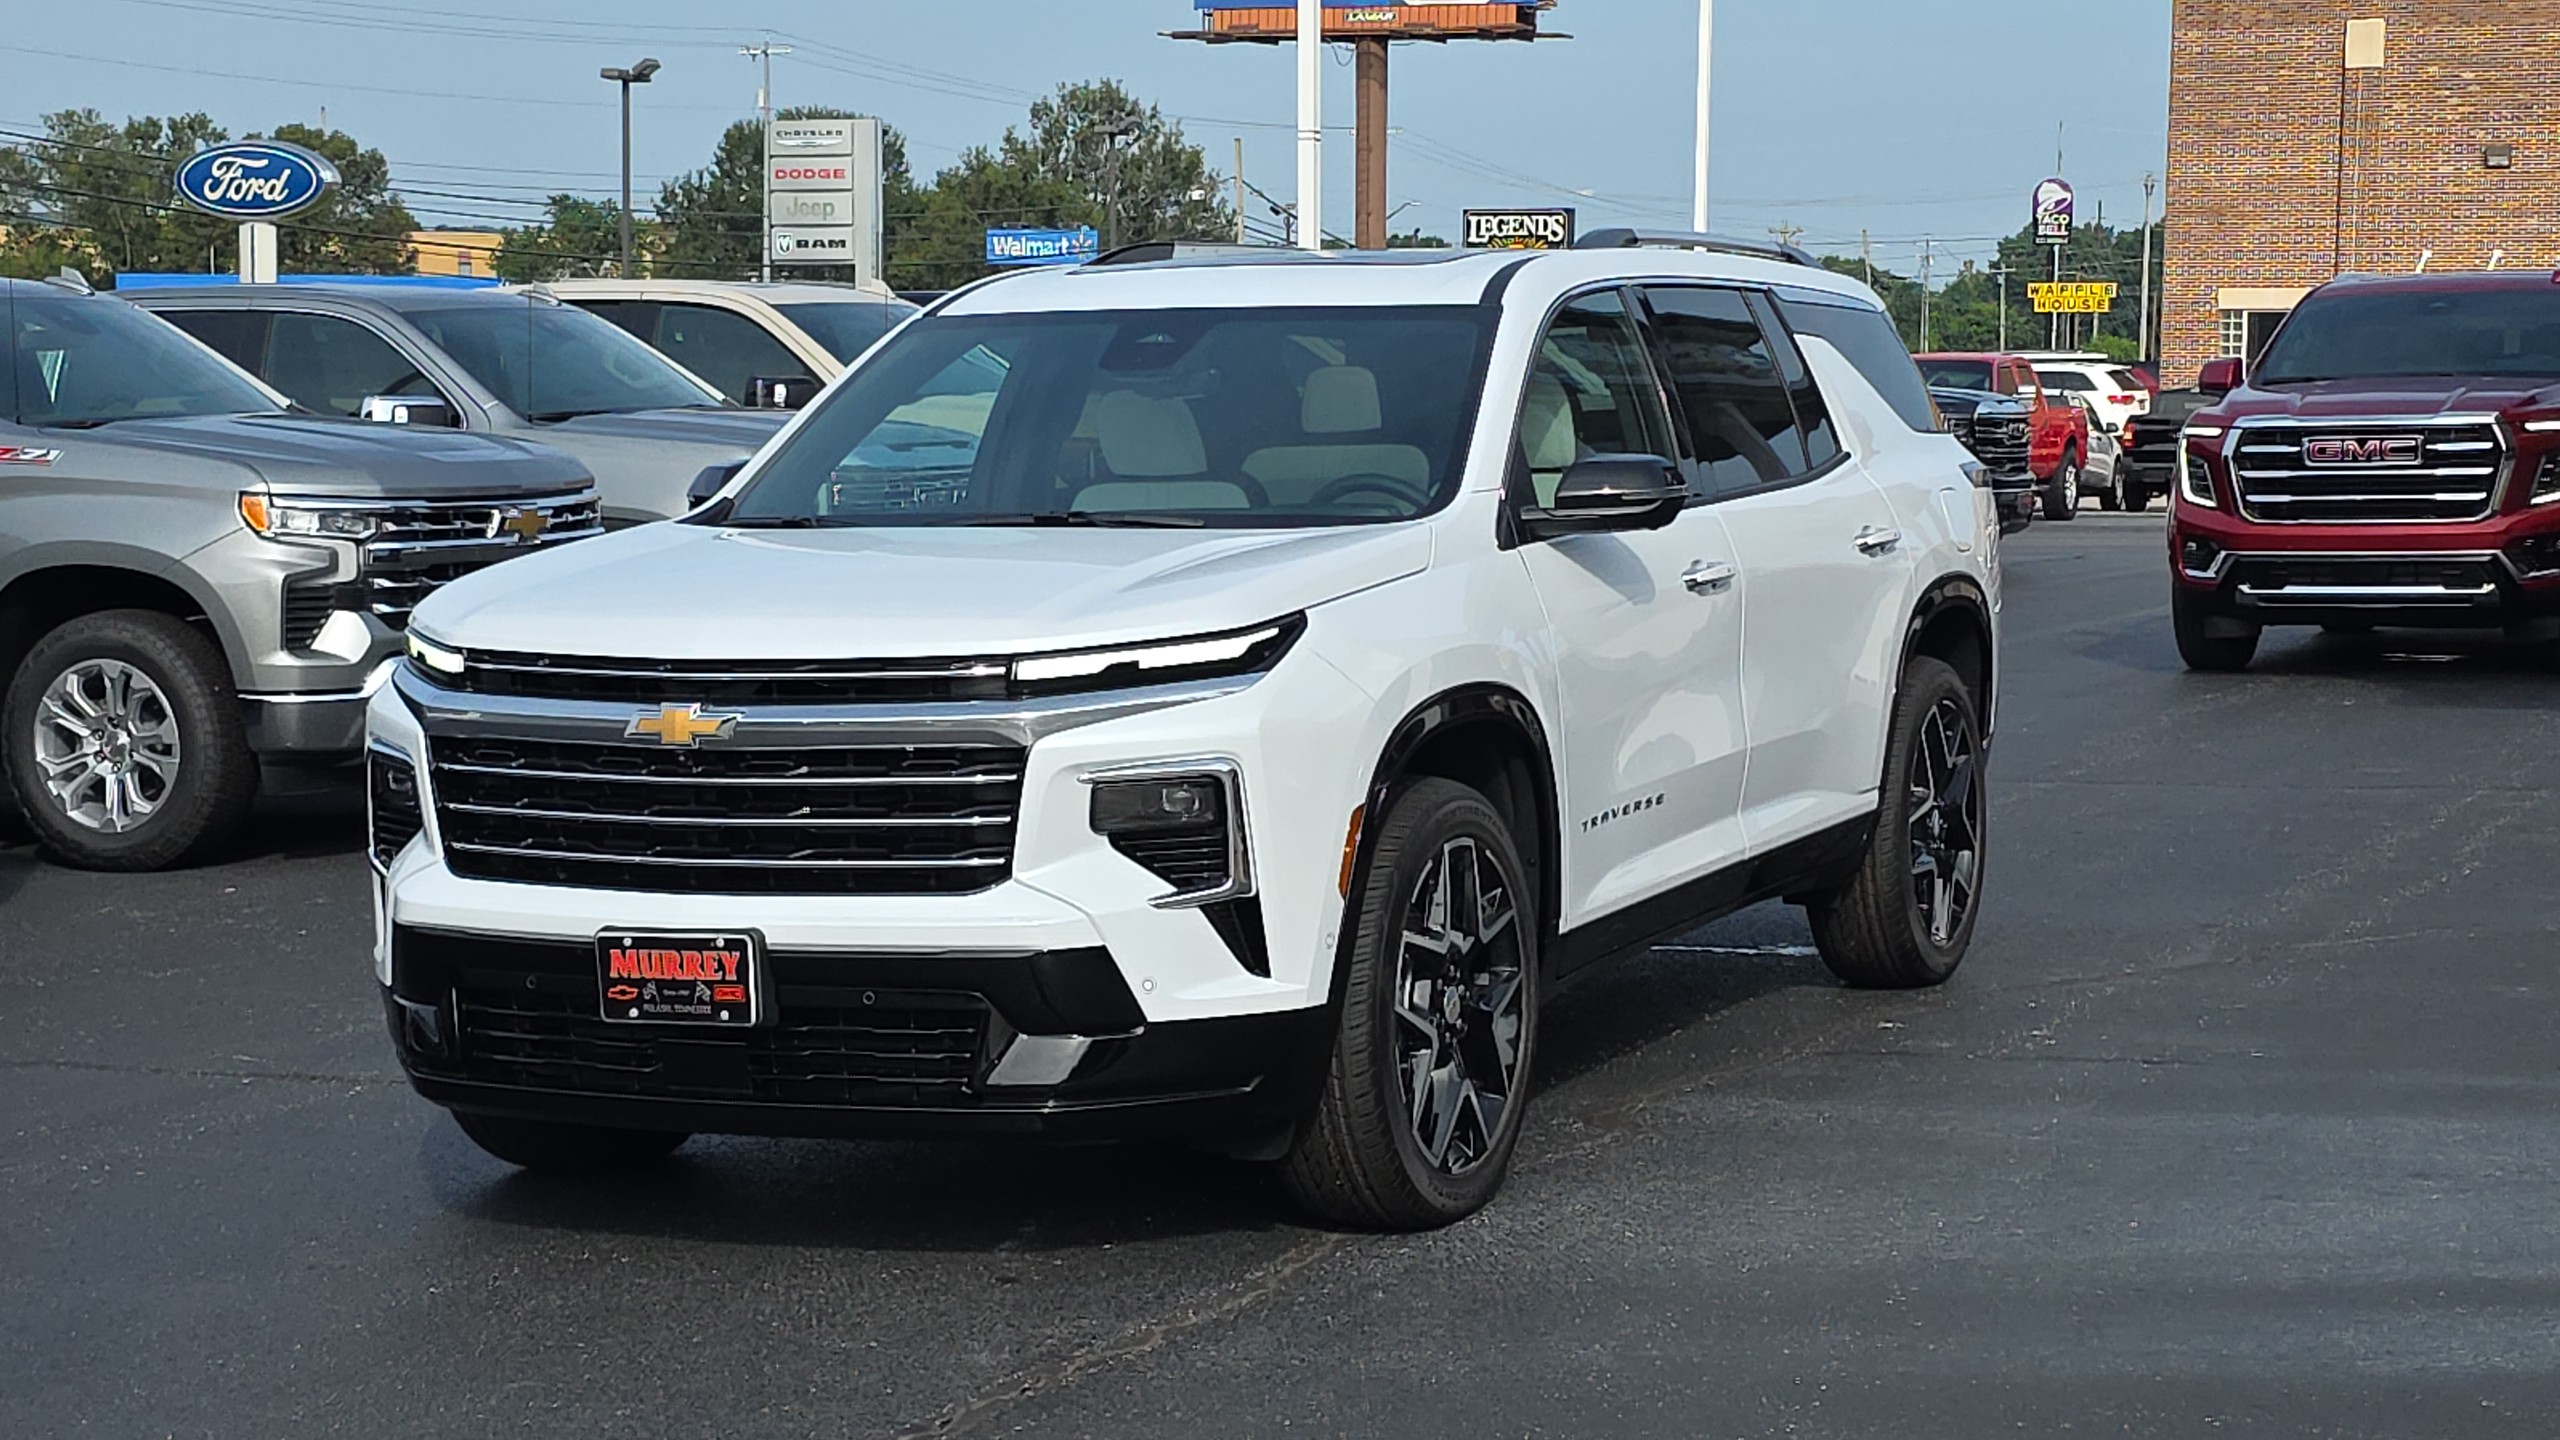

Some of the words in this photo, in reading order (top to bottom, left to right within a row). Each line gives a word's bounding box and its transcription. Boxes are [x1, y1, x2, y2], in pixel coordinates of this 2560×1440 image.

[203, 156, 292, 202] Ford
[774, 169, 846, 180] DODGE
[786, 197, 835, 220] Jeep
[2035, 213, 2070, 225] TACO
[1467, 215, 1565, 243] LEGENDS
[2038, 225, 2069, 236] BELL
[796, 239, 846, 249] RAM
[992, 236, 1069, 257] Walmart
[2030, 285, 2114, 297] WAFFLE
[2037, 299, 2107, 310] HOUSE
[2309, 440, 2416, 461] GMC
[1581, 793, 1665, 834] TRAVERSE
[609, 948, 740, 981] MURREY
